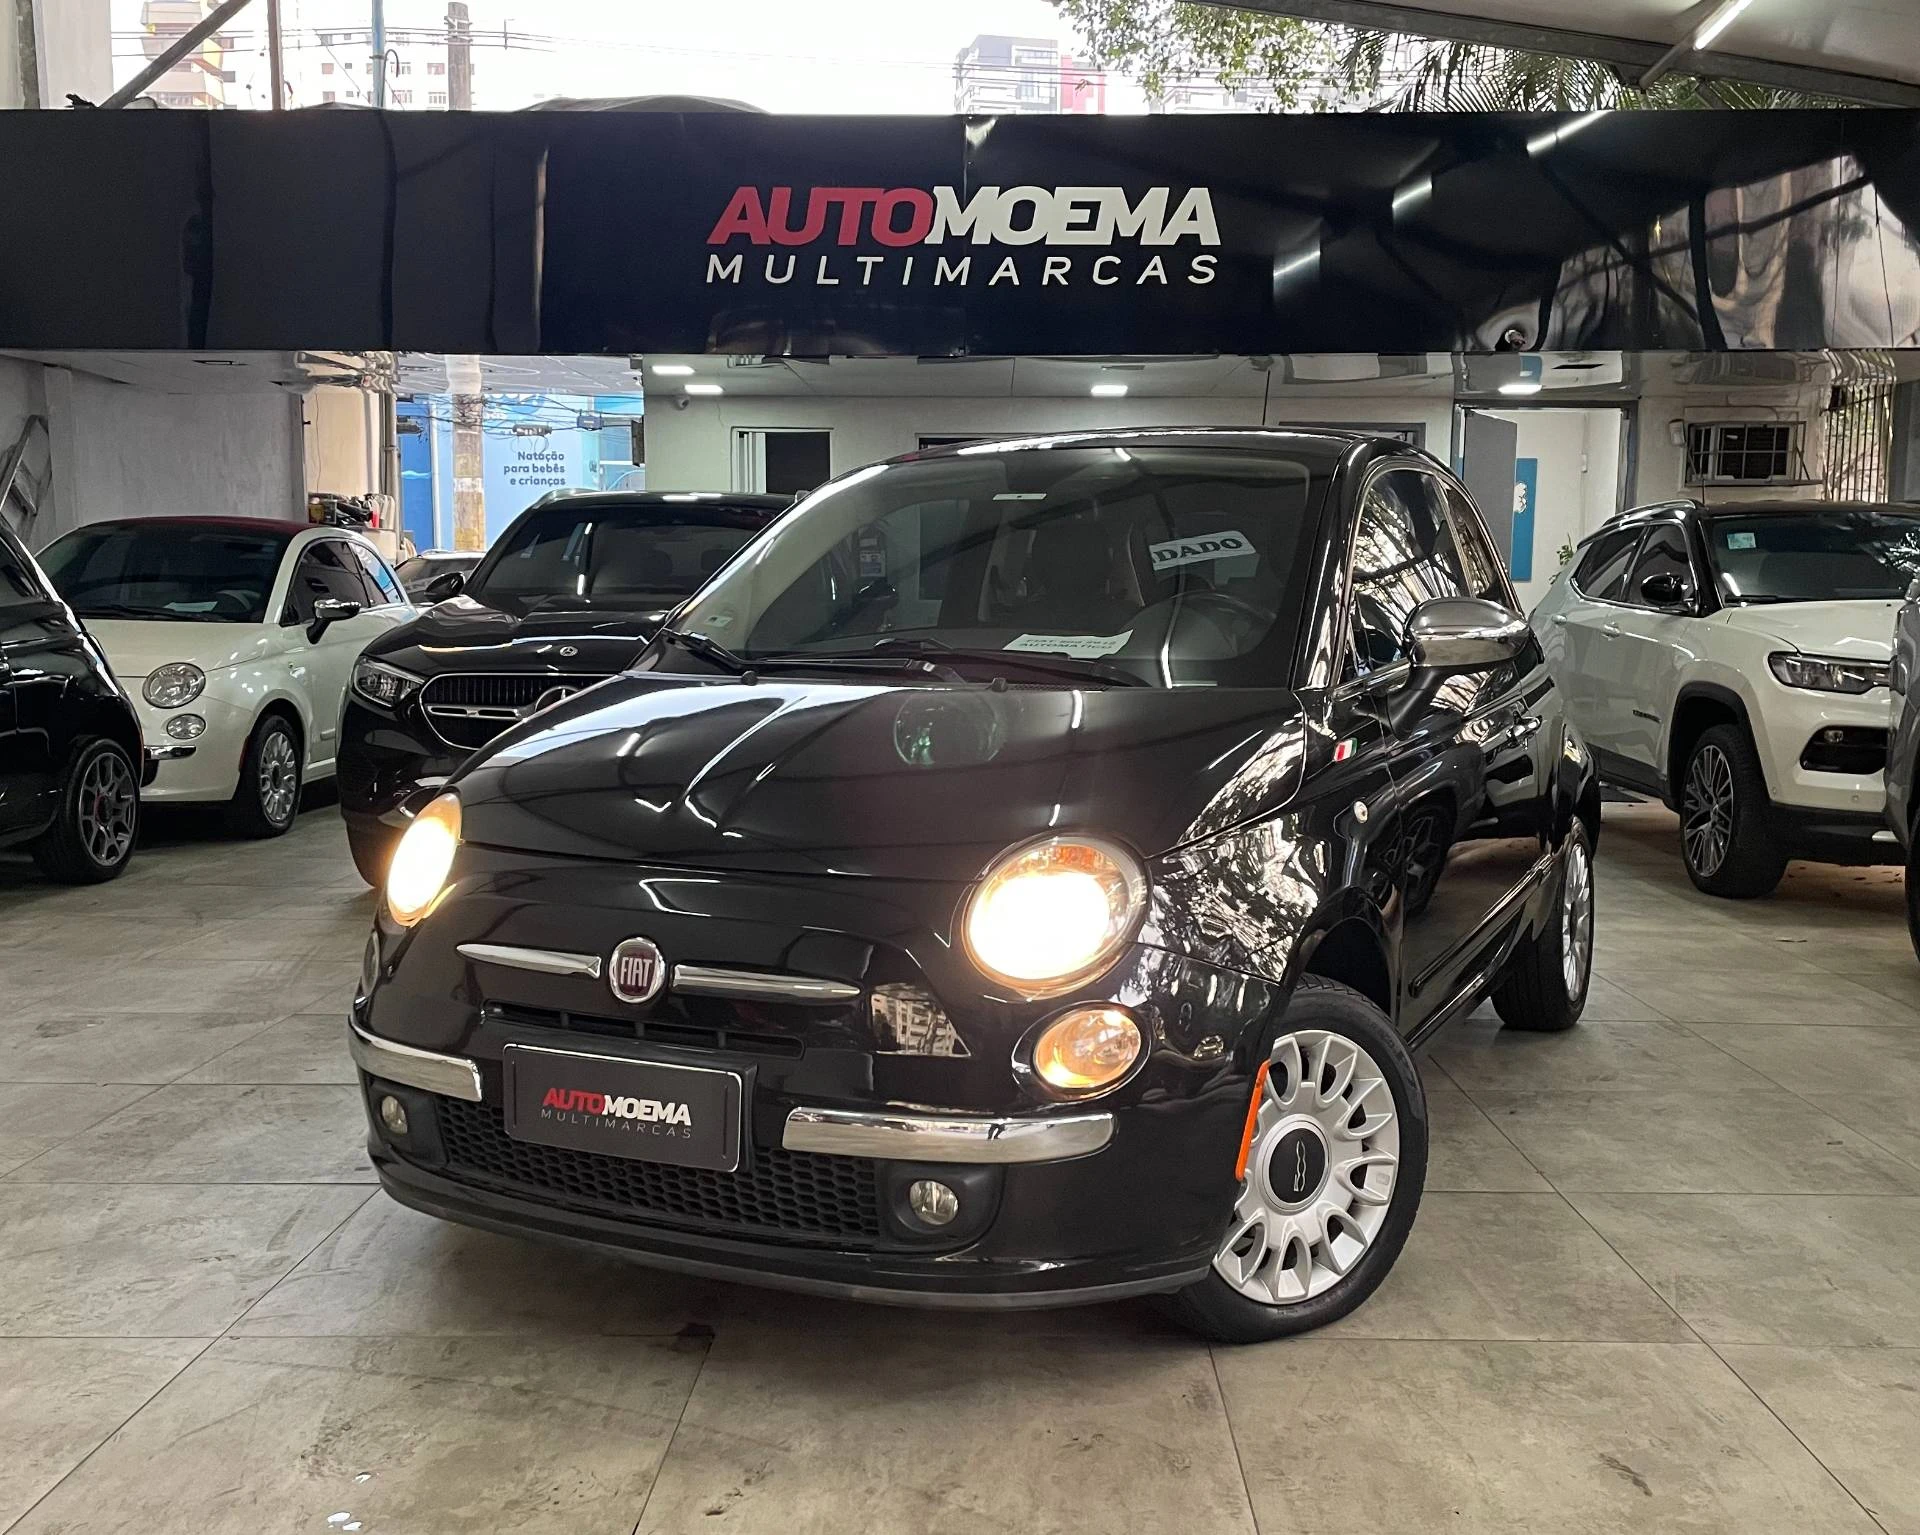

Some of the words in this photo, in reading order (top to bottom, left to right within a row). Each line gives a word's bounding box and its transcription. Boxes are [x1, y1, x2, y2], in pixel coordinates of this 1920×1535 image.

[706, 254, 1219, 286] MULTIMARCAS
[503, 465, 530, 475] para
[532, 463, 565, 473] bebês
[518, 451, 564, 462] Natação
[518, 476, 566, 486] crianças
[1152, 538, 1242, 564] DADO
[620, 956, 653, 988] FIAT
[541, 1109, 692, 1139] MULTIMARCAS
